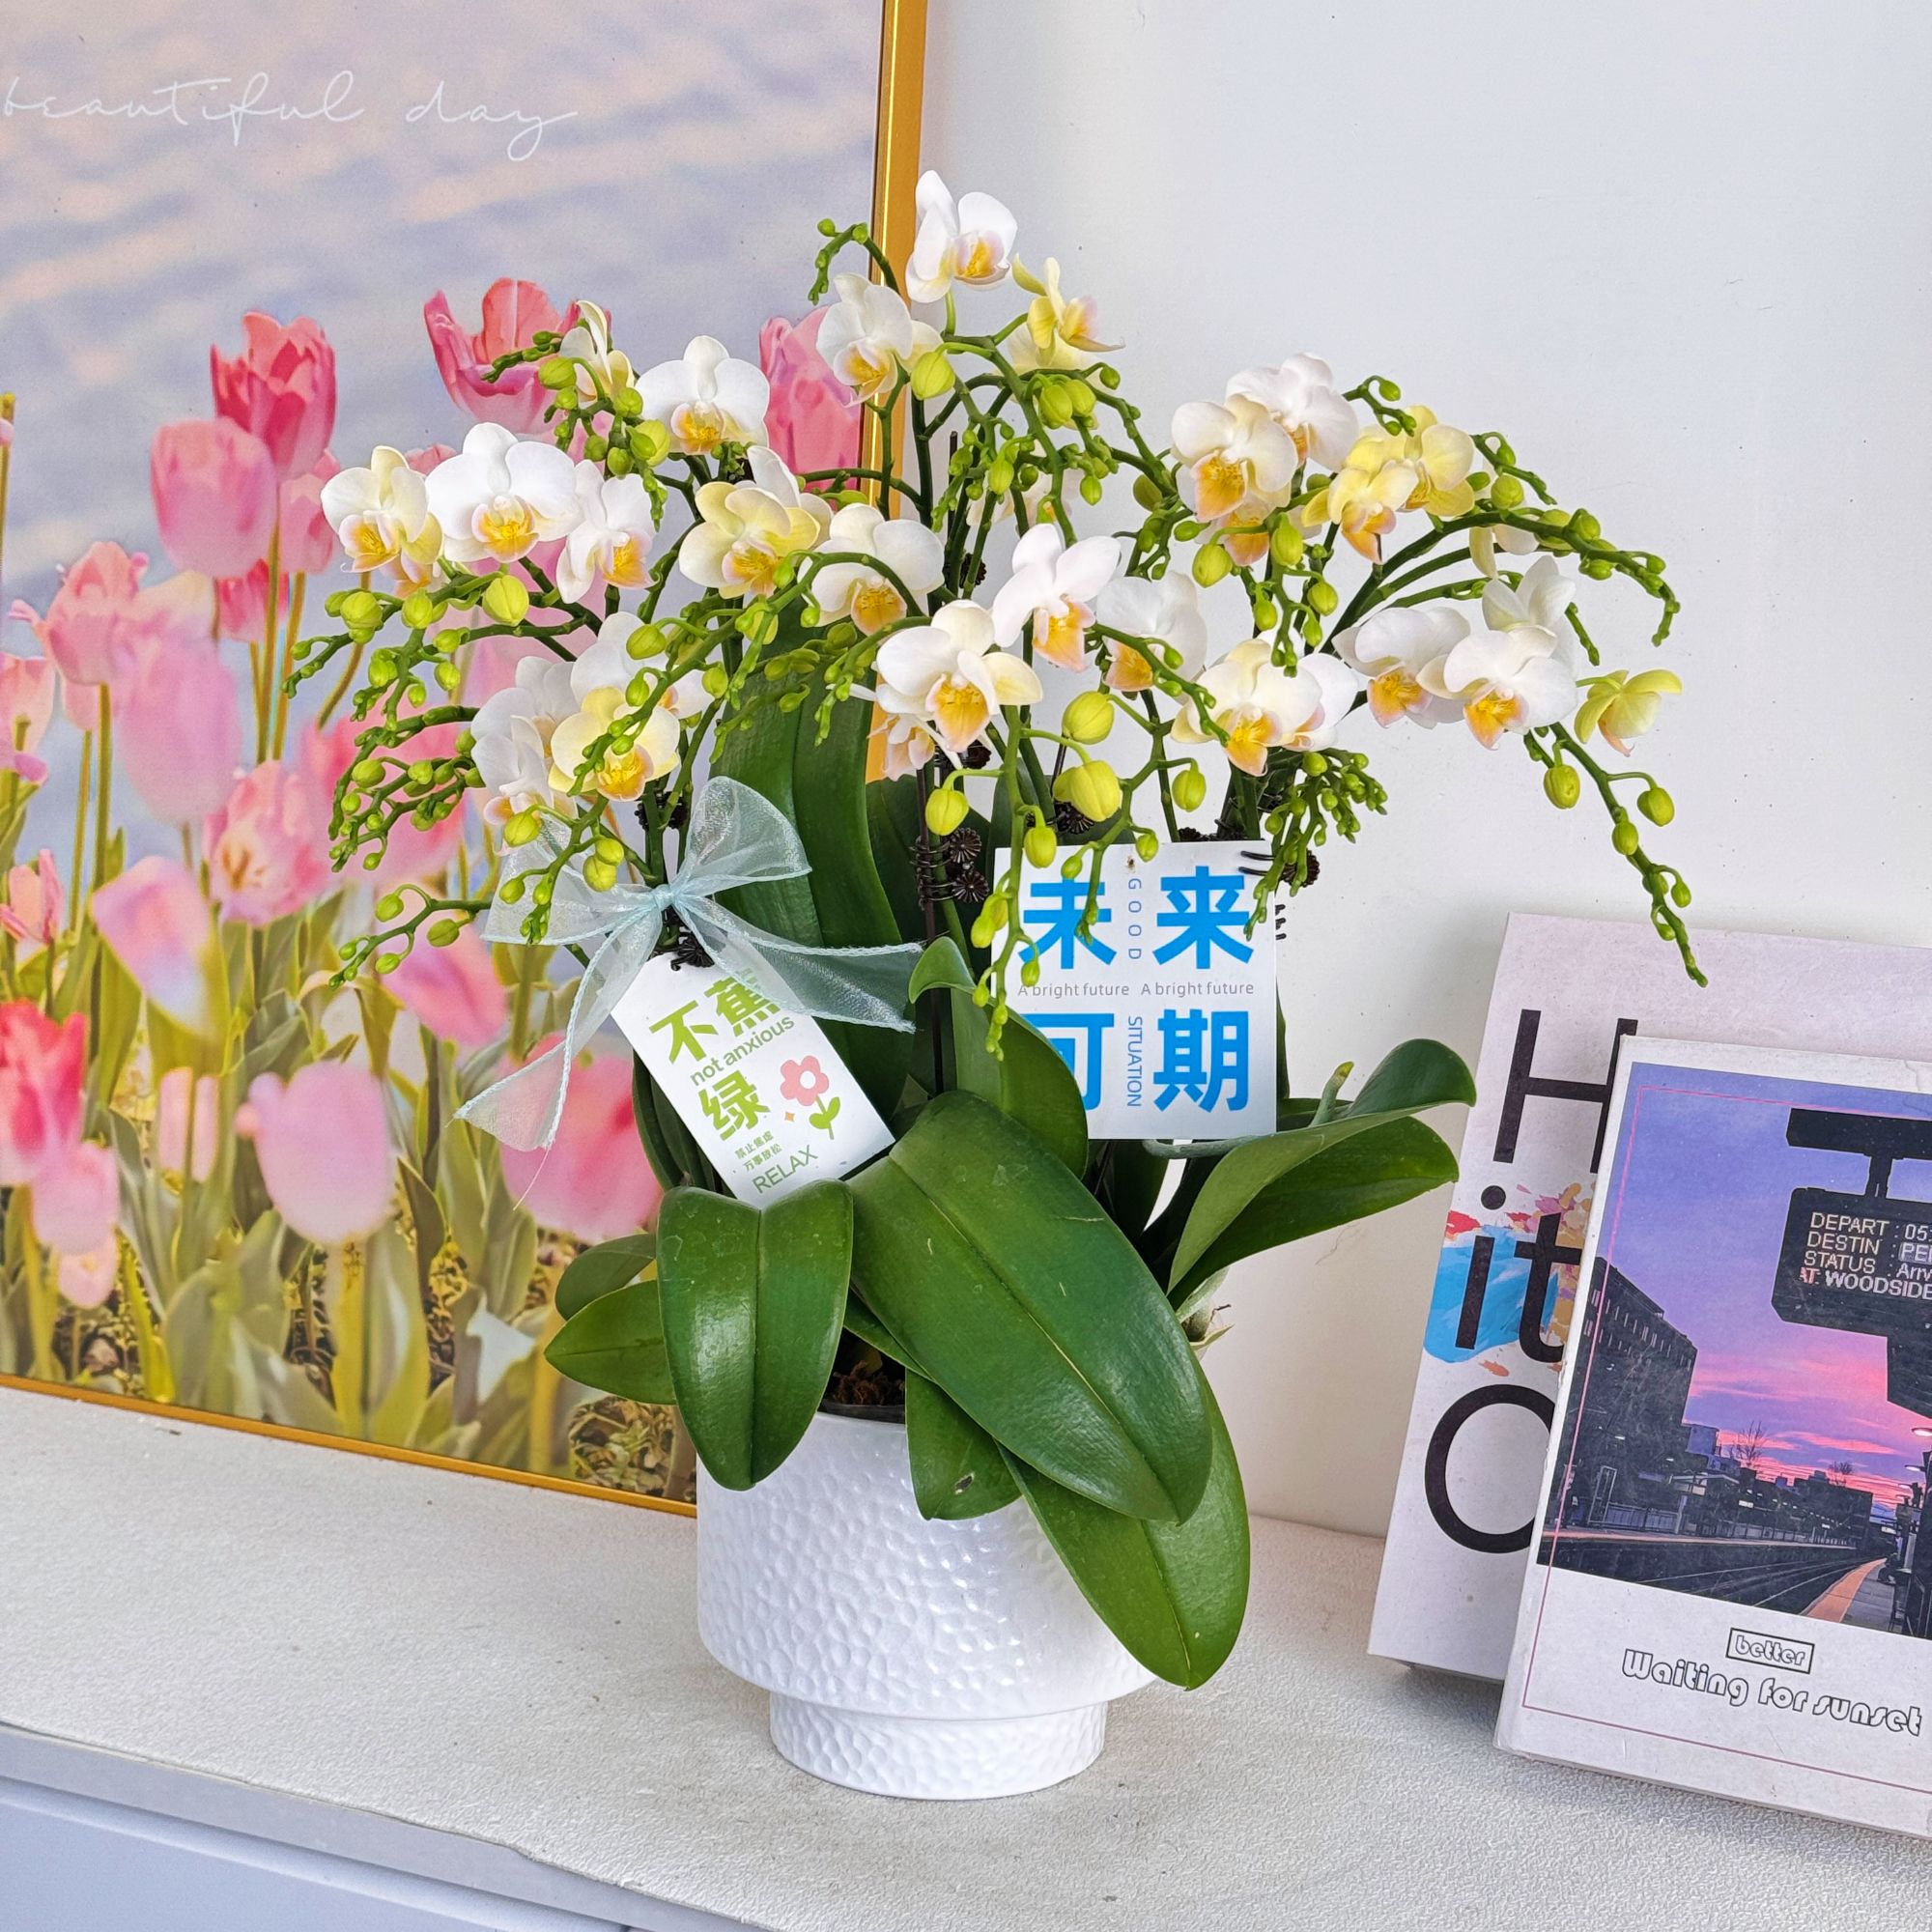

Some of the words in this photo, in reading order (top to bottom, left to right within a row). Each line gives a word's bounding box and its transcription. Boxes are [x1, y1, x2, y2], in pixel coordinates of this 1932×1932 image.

[4, 71, 364, 146] beautiful
[406, 80, 579, 161] day
[1128, 877, 1142, 960] GOOD
[1017, 984, 1029, 997] A
[1033, 983, 1079, 999] bright
[1083, 983, 1129, 997] future
[1140, 983, 1151, 996] A
[1155, 981, 1203, 998] bright
[1207, 981, 1255, 996] future
[690, 1057, 724, 1087] not
[724, 1016, 795, 1067] anxious
[1127, 1015, 1143, 1107] SITUATION
[698, 1069, 771, 1141] 绿
[753, 1144, 818, 1193] RELAX
[1806, 1230, 1881, 1256] DESTIN
[1810, 1211, 1890, 1236] DEPART
[1804, 1250, 1876, 1274] STATUS
[1825, 1269, 1932, 1300] WOODSIDE
[1735, 1634, 1805, 1666] better
[1622, 1648, 1749, 1707] Waiting
[1757, 1677, 1809, 1712] for
[1812, 1694, 1922, 1737] sunset
